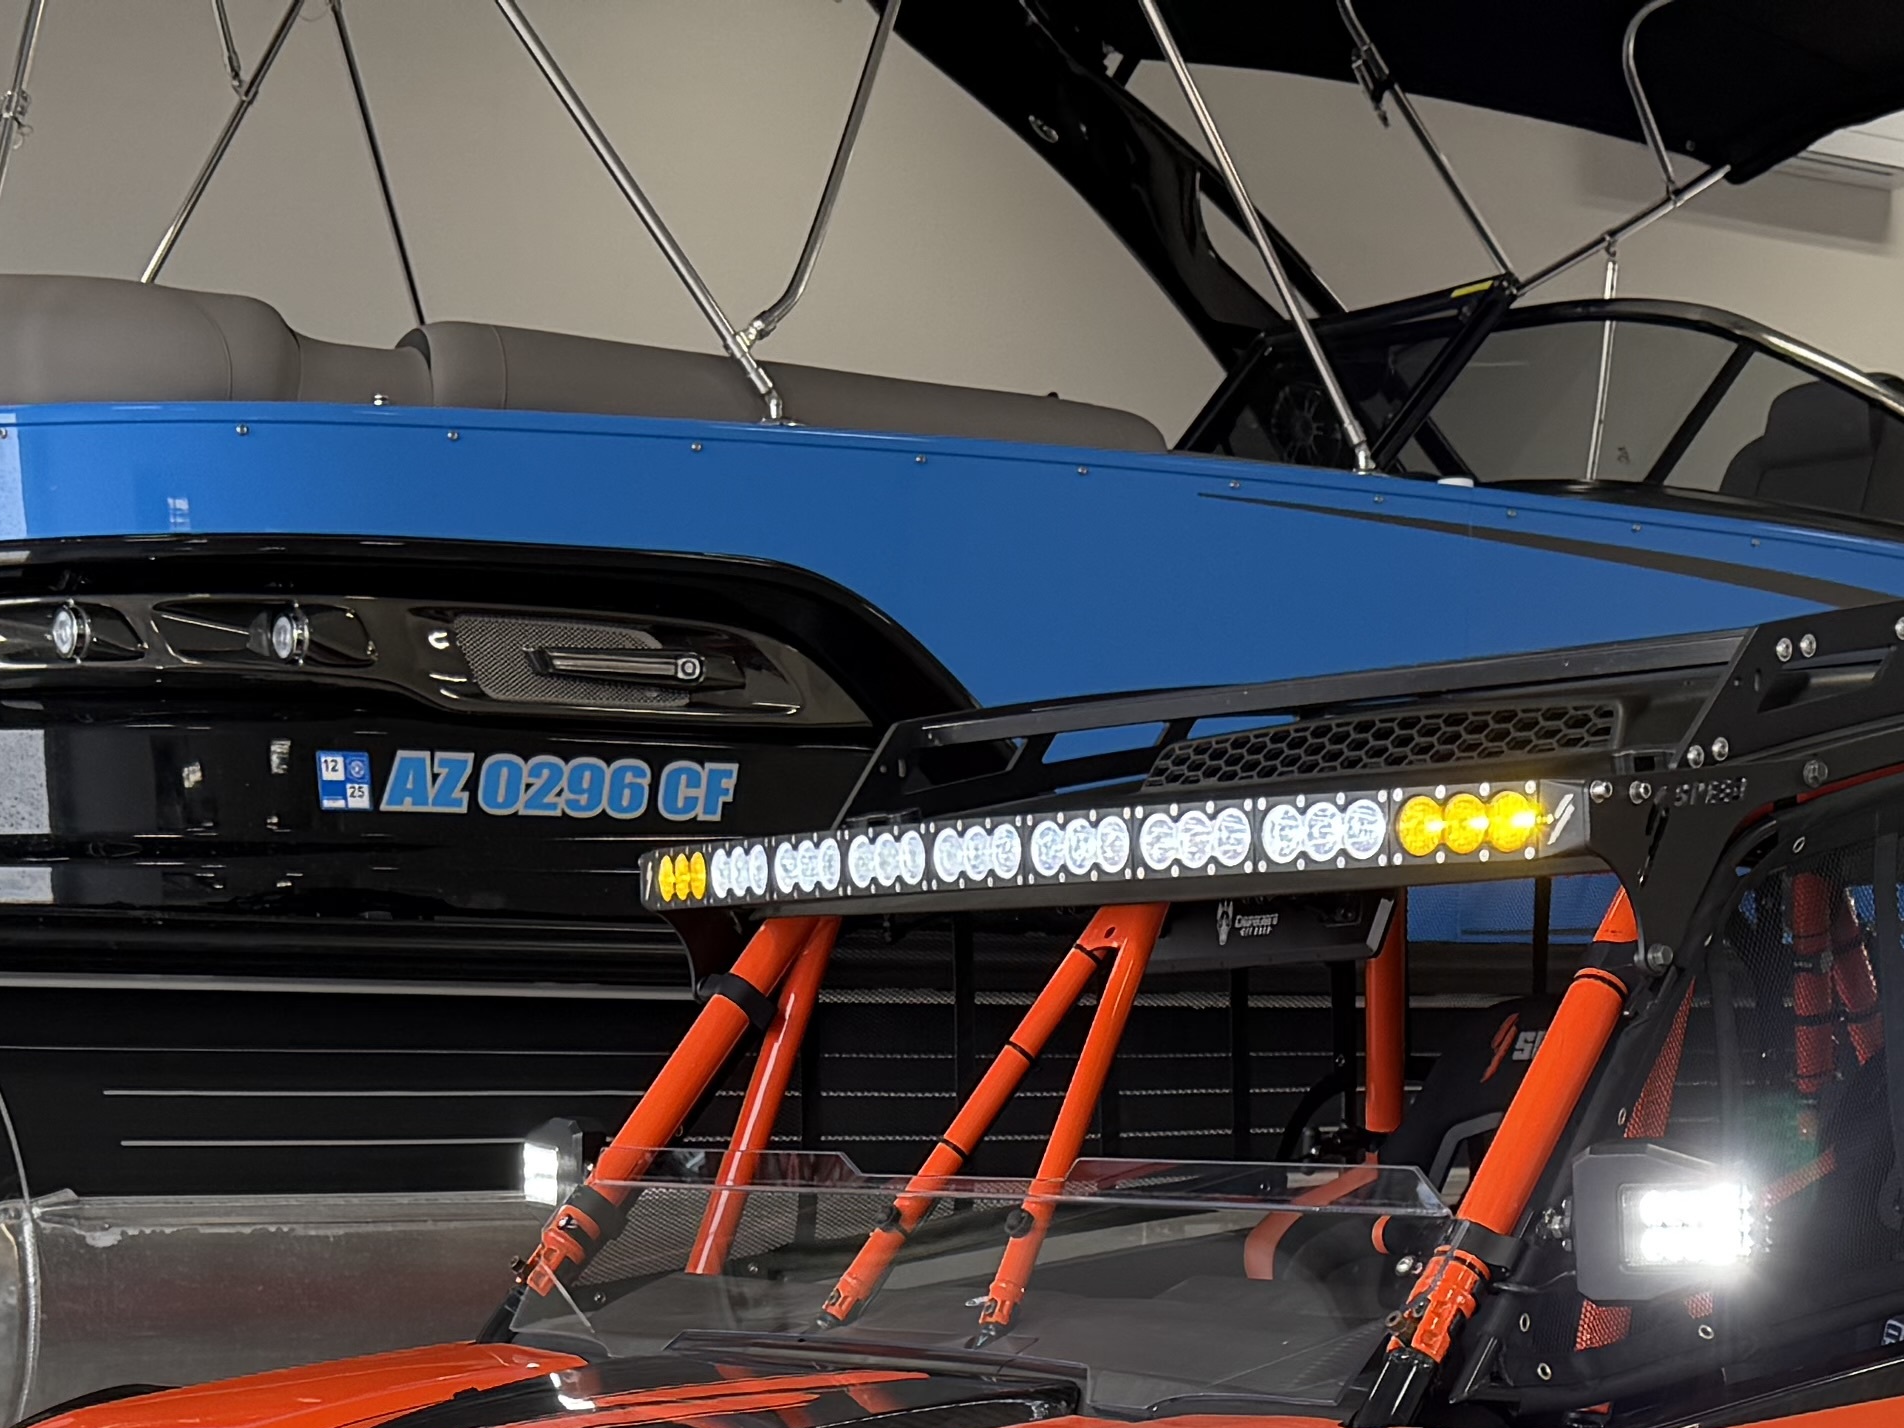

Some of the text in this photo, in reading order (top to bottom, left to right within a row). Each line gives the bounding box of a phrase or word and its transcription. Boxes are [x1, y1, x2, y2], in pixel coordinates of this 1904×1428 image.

[323, 759, 339, 772] 12
[349, 786, 365, 799] 25
[379, 750, 740, 822] AZ 0296 CF
